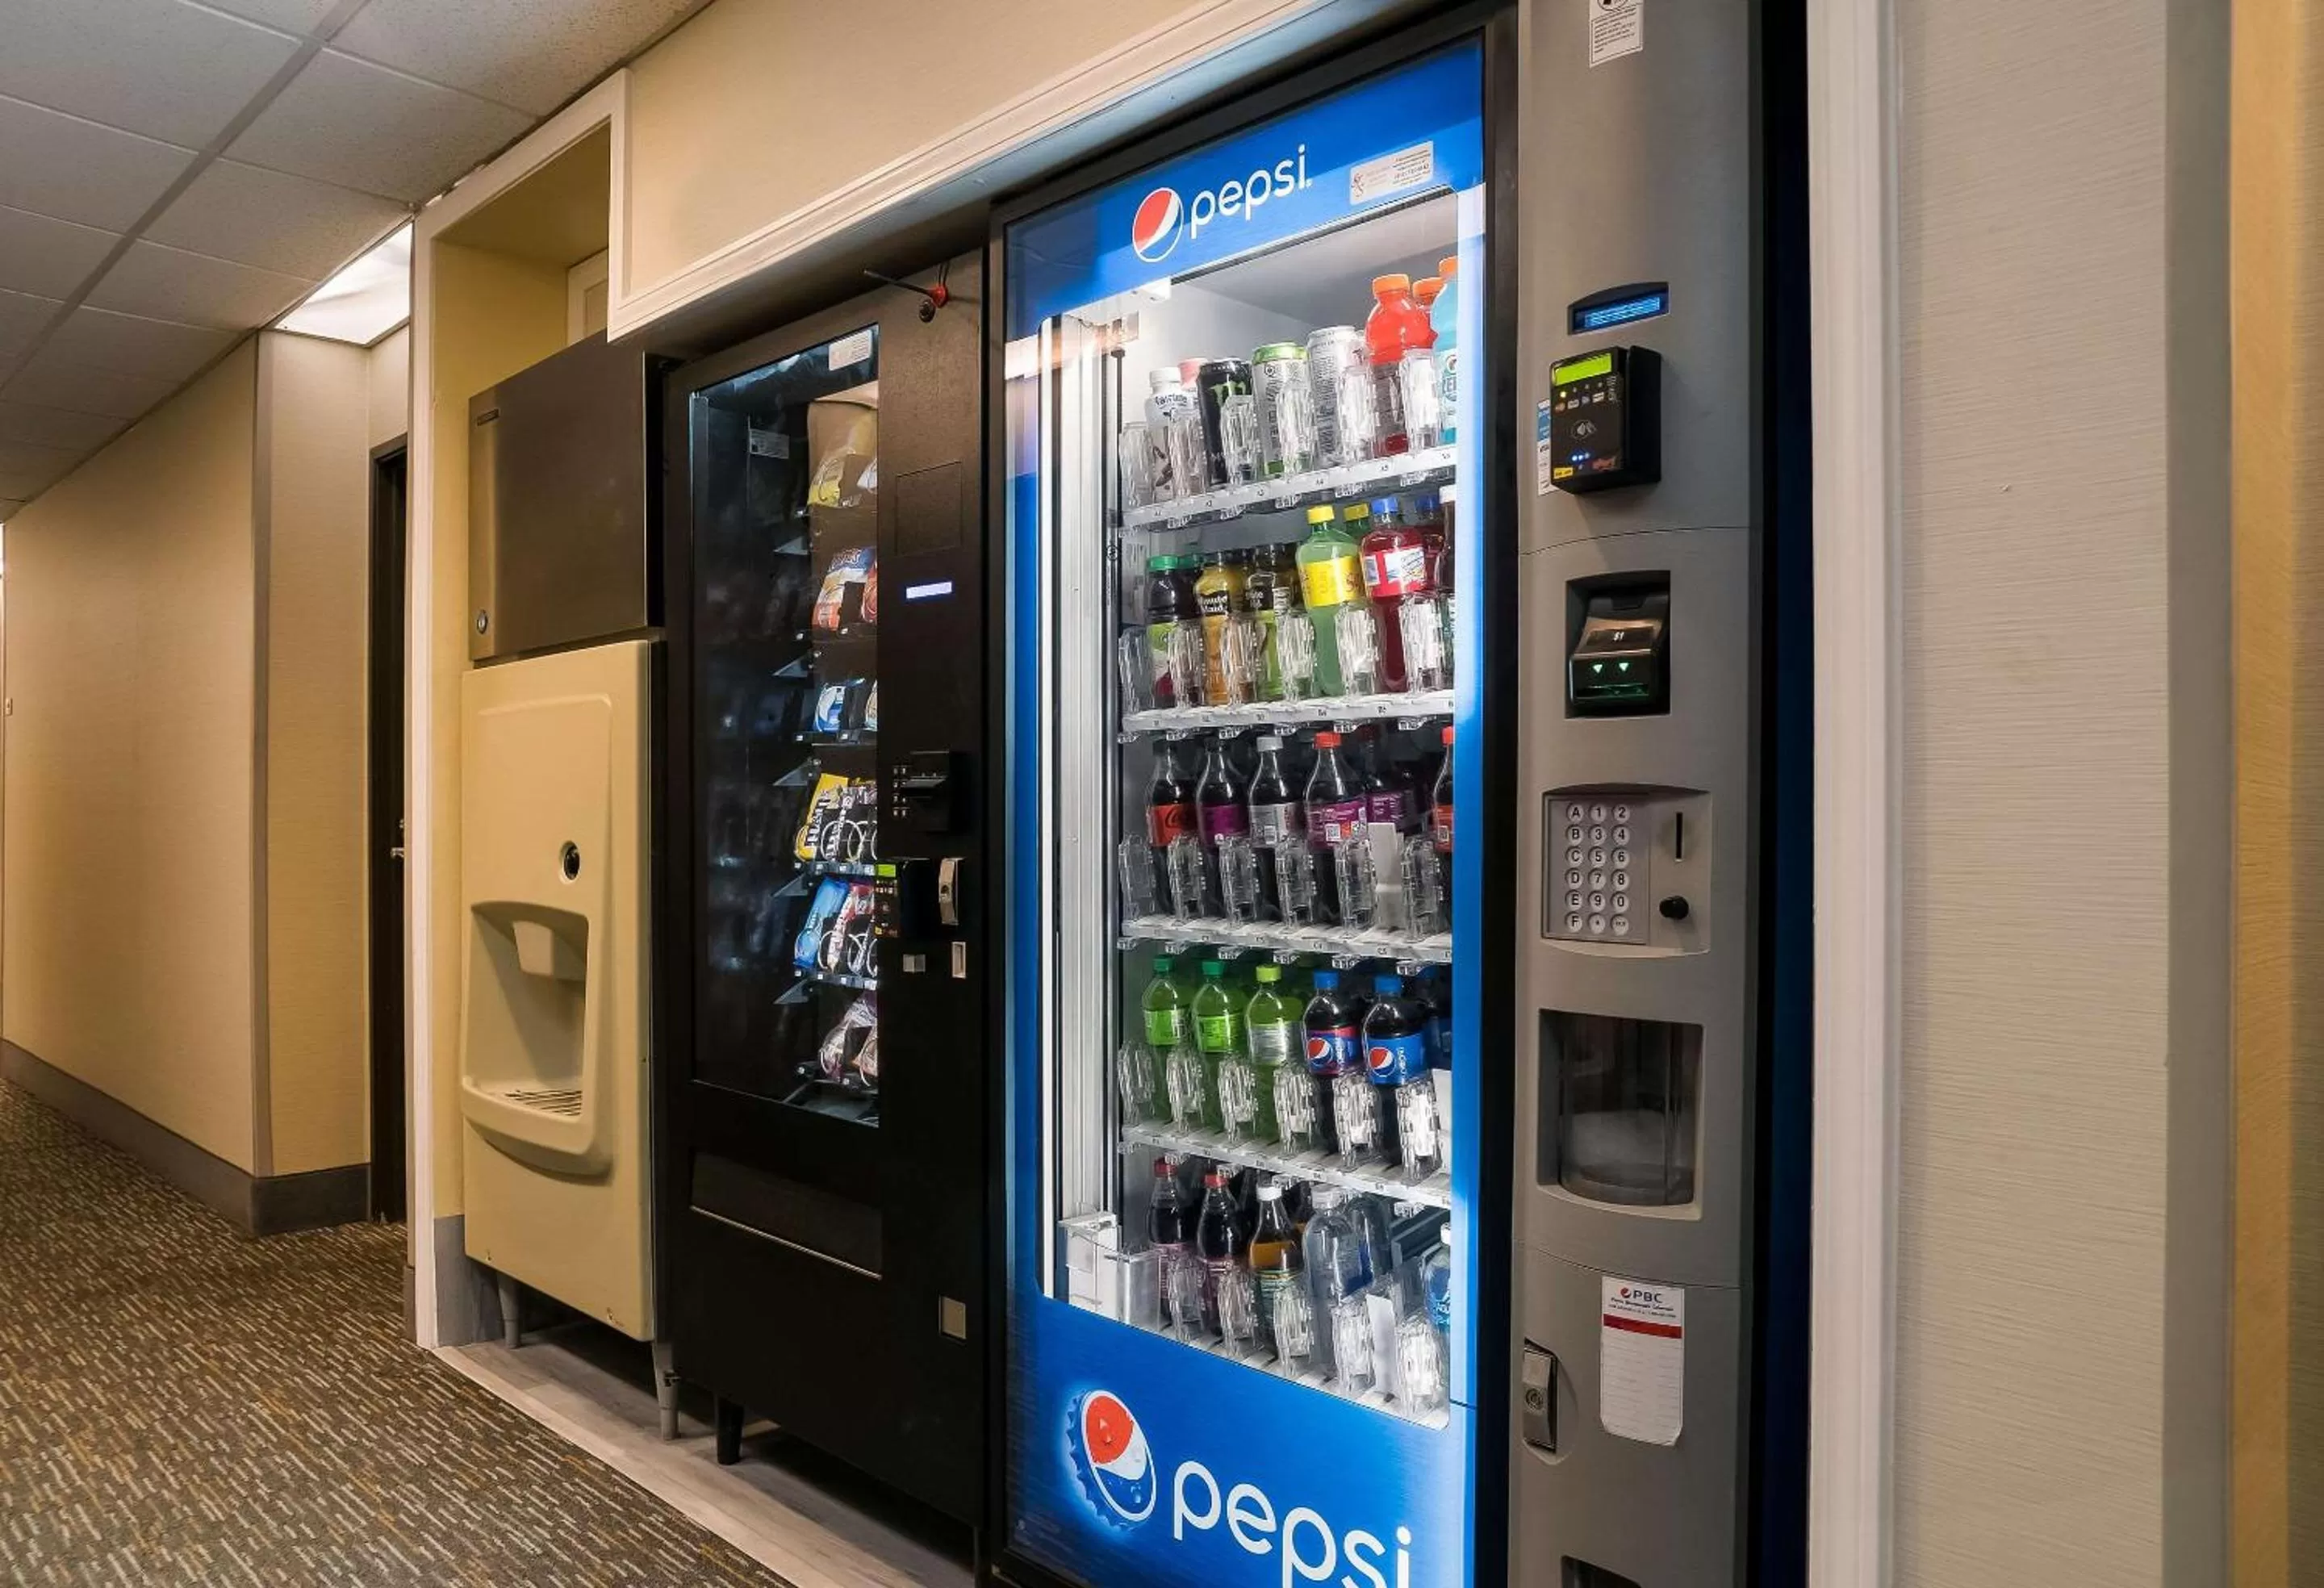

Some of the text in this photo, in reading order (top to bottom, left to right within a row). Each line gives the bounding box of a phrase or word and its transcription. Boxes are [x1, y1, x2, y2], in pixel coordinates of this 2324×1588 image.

[1189, 144, 1308, 240] pepsi
[1572, 807, 1625, 817] A 1 2
[1573, 830, 1624, 840] B 3 4
[1573, 850, 1624, 862] C 5 6
[1572, 872, 1624, 885] D 7 8
[1572, 894, 1579, 905] E
[1595, 896, 1601, 906] 9
[1632, 1289, 1663, 1304] PBC
[1174, 1461, 1411, 1588] pepsi
